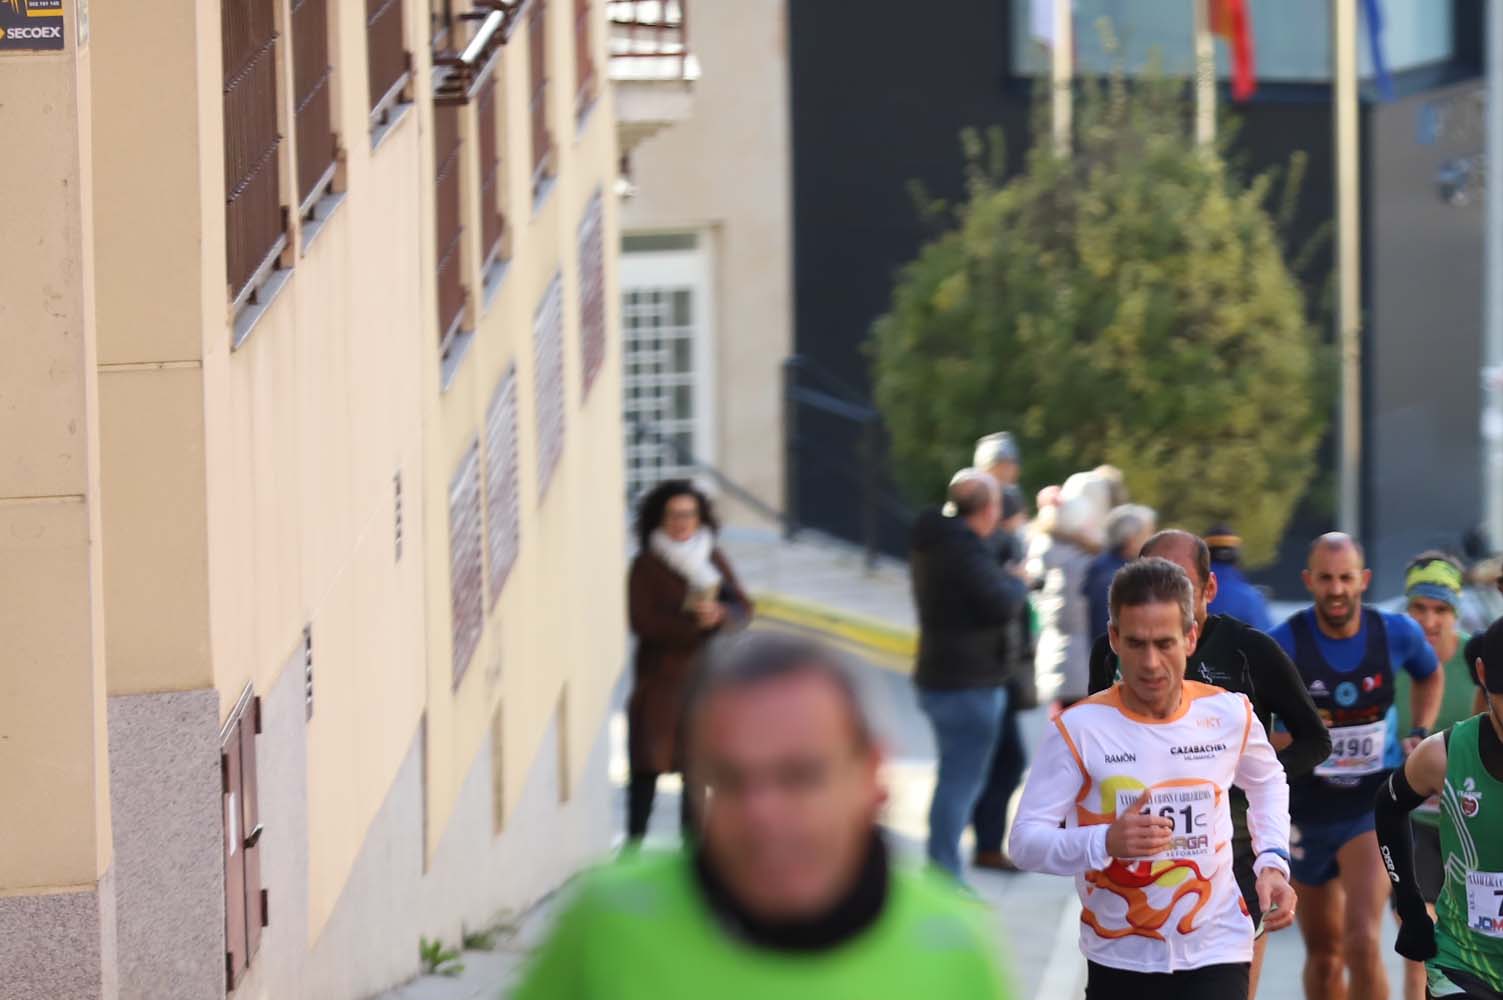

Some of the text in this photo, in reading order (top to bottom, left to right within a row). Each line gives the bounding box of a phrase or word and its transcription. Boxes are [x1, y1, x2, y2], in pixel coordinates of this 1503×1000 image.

[7, 27, 61, 39] SECOEX
[1334, 737, 1373, 757] 490
[1104, 752, 1136, 763] RAMÓN
